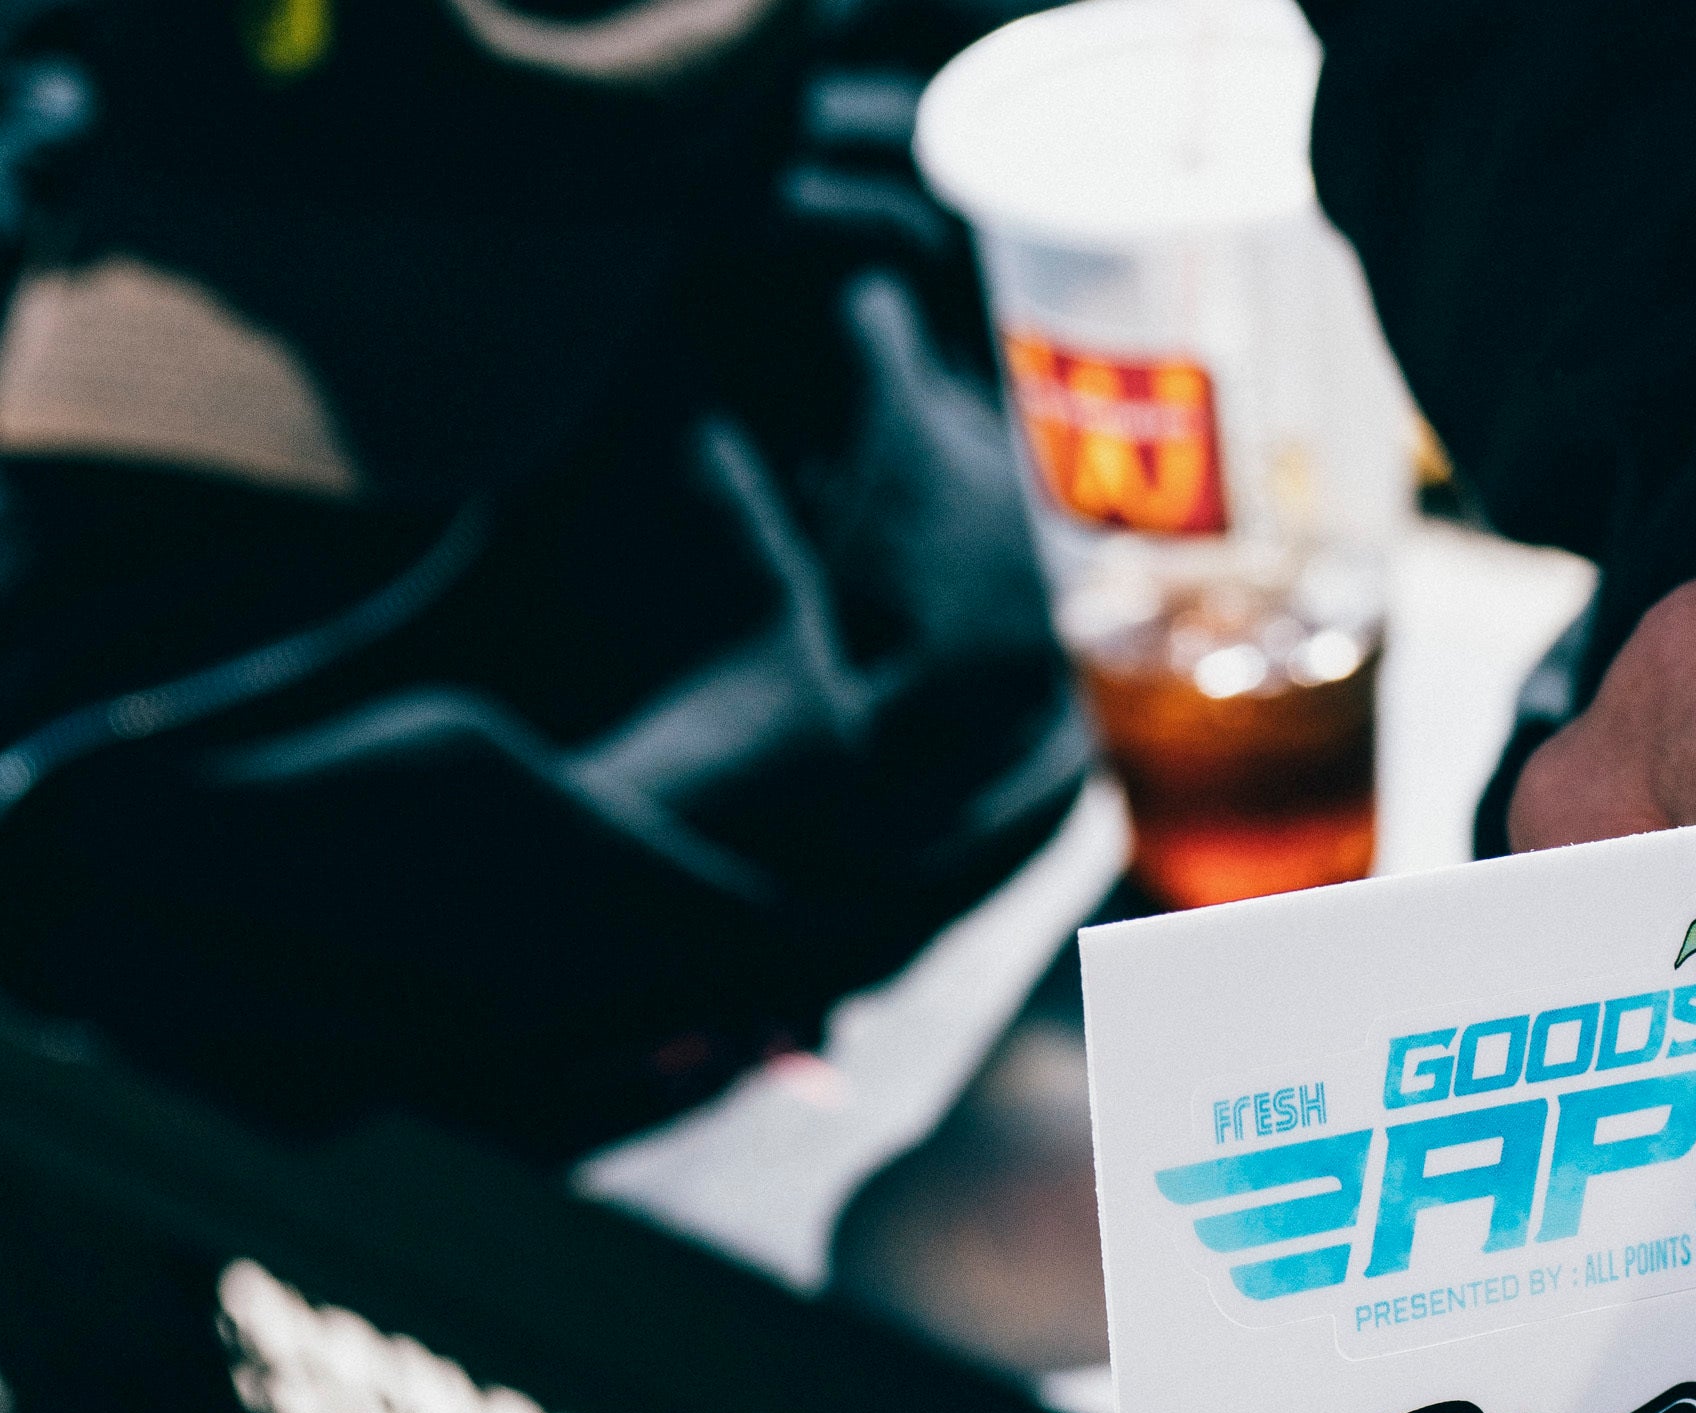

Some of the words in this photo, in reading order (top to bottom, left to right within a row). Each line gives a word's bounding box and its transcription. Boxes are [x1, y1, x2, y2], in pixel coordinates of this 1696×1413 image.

[1354, 1274, 1520, 1332] PRESENTED
[1528, 1263, 1562, 1297] BY
[1584, 1250, 1619, 1288] ALL
[1624, 1233, 1692, 1278] POINTS
